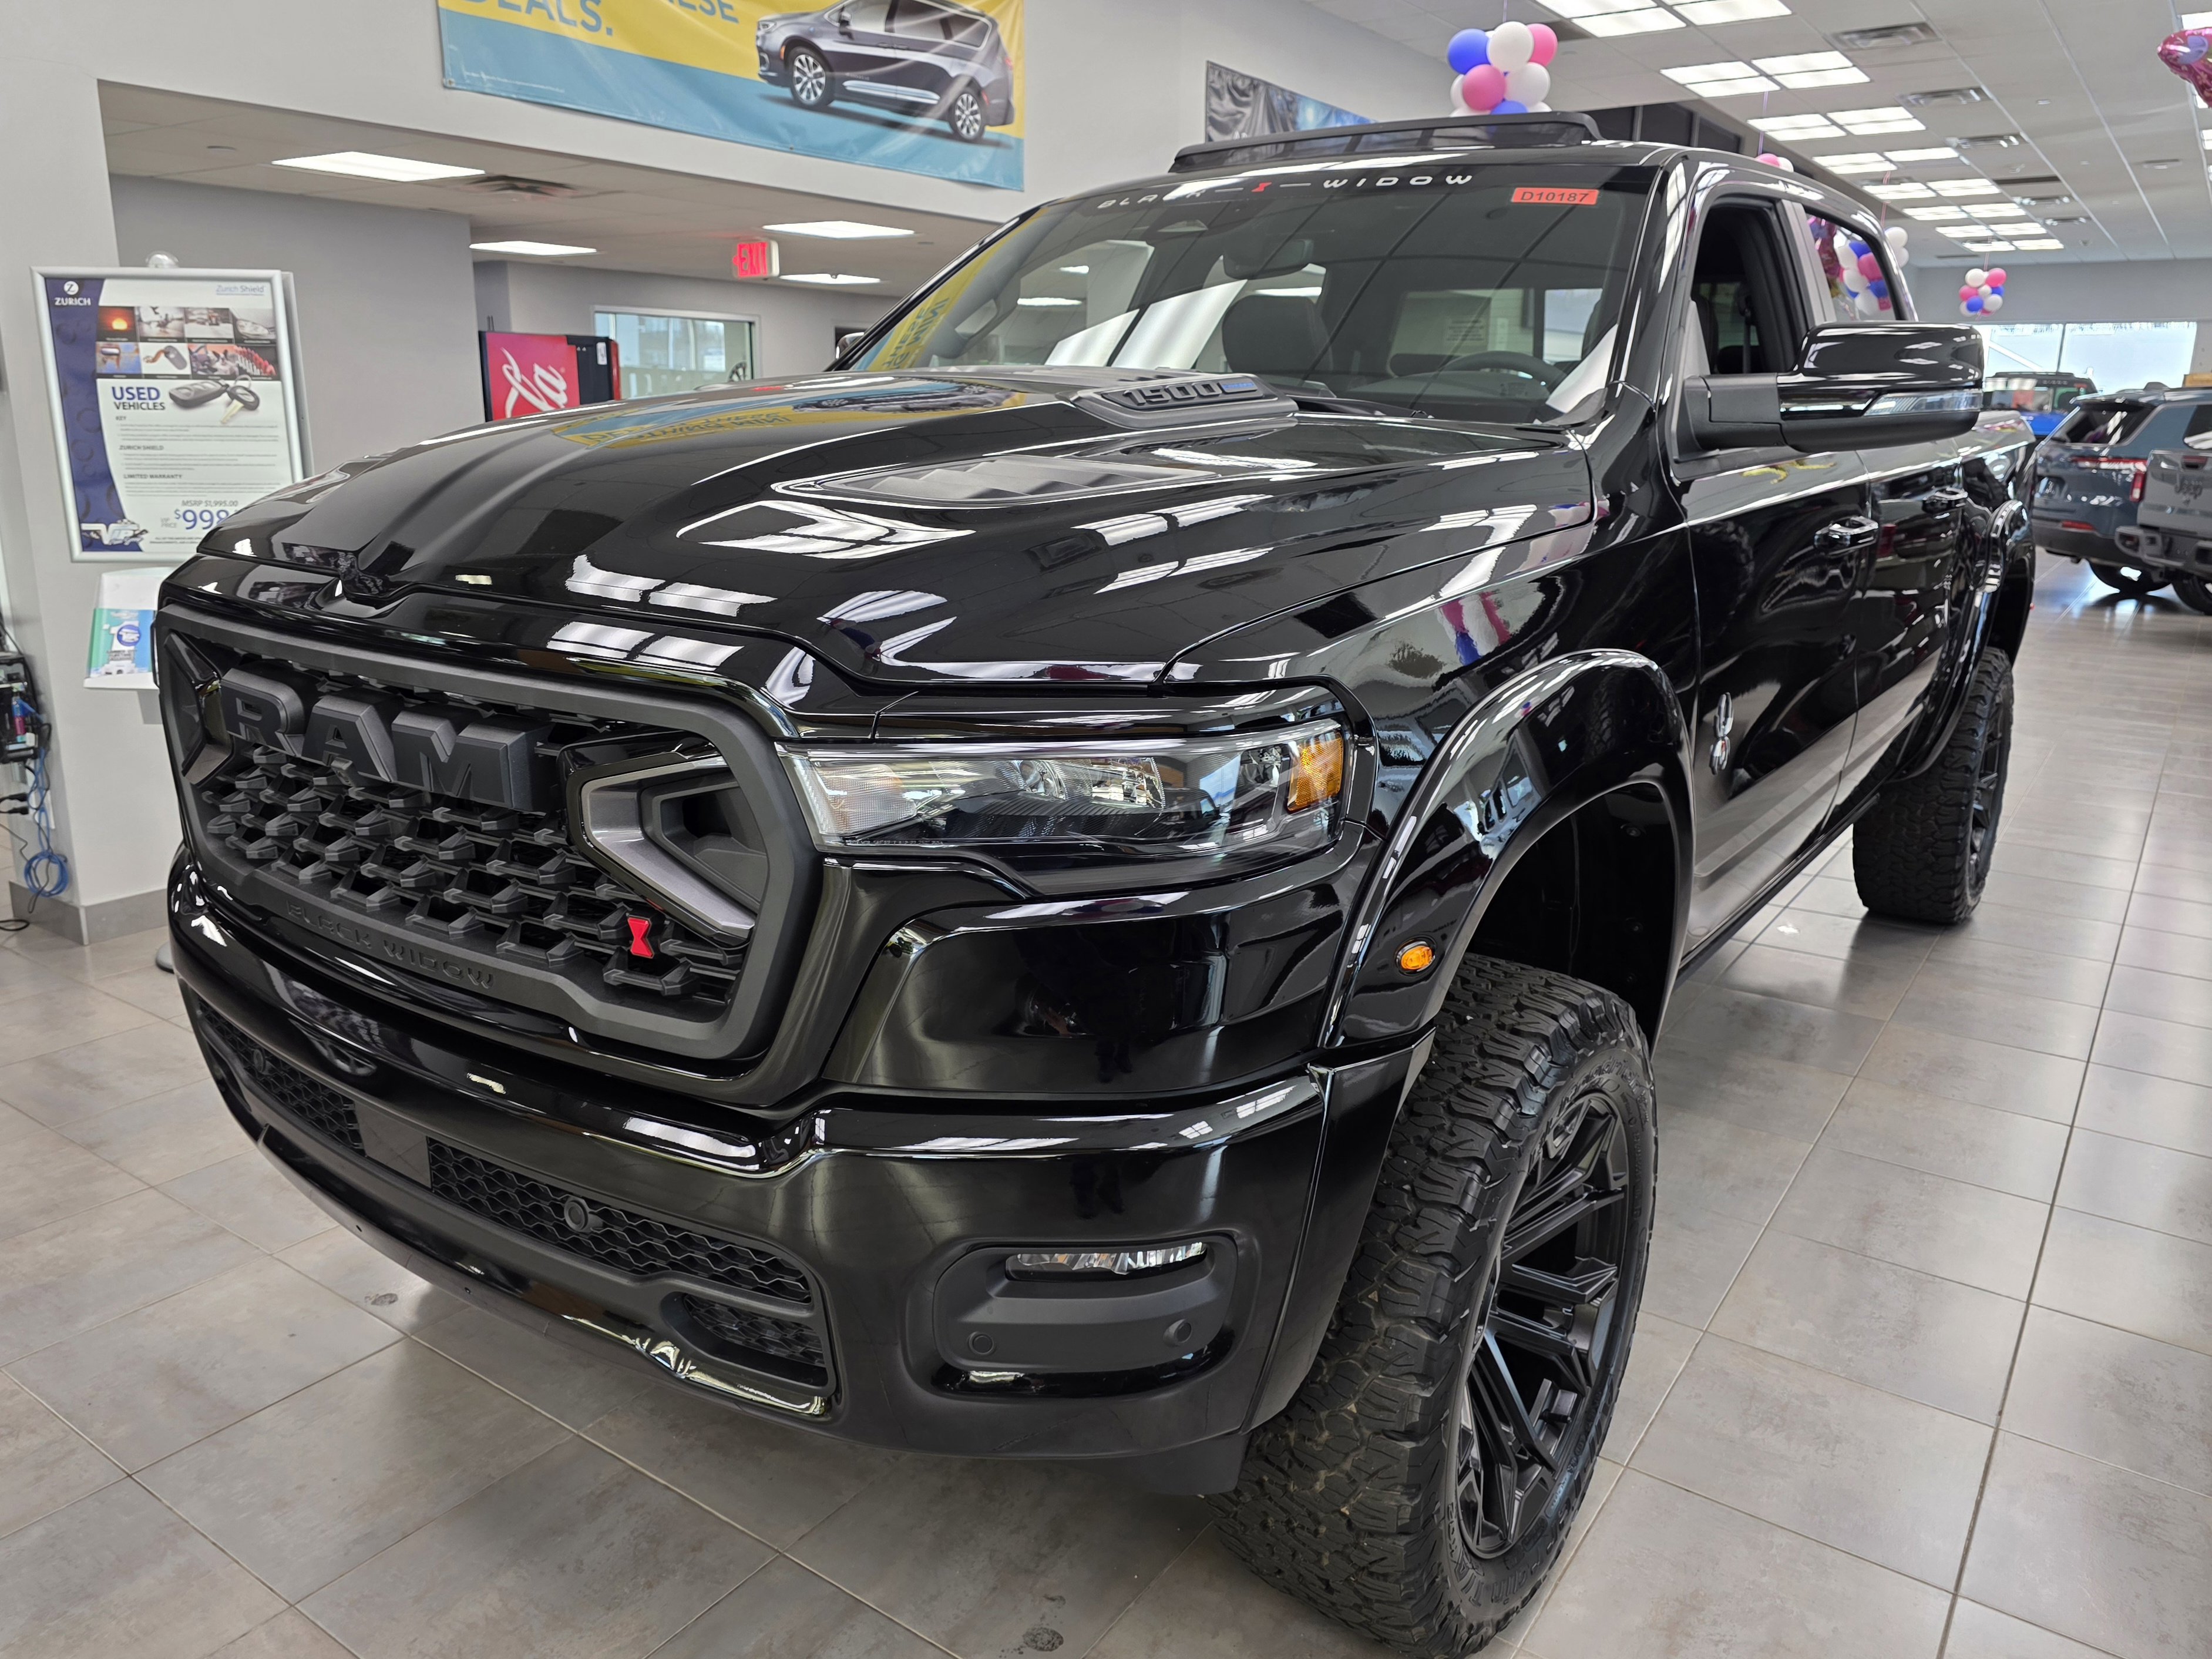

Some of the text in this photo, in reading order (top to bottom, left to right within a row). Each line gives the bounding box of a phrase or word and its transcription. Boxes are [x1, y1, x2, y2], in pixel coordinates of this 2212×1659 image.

[472, 0, 613, 36] ALS.
[1323, 175, 1473, 189] WIDOW
[1520, 191, 1589, 203] D10187
[738, 241, 768, 276] EXIT
[55, 297, 91, 305] ZURICH
[112, 386, 160, 401] USED
[1123, 381, 1223, 406] 1500
[114, 401, 166, 410] VEHICLES
[221, 668, 532, 812] RAM
[287, 900, 495, 990] BLACK WIDOW
